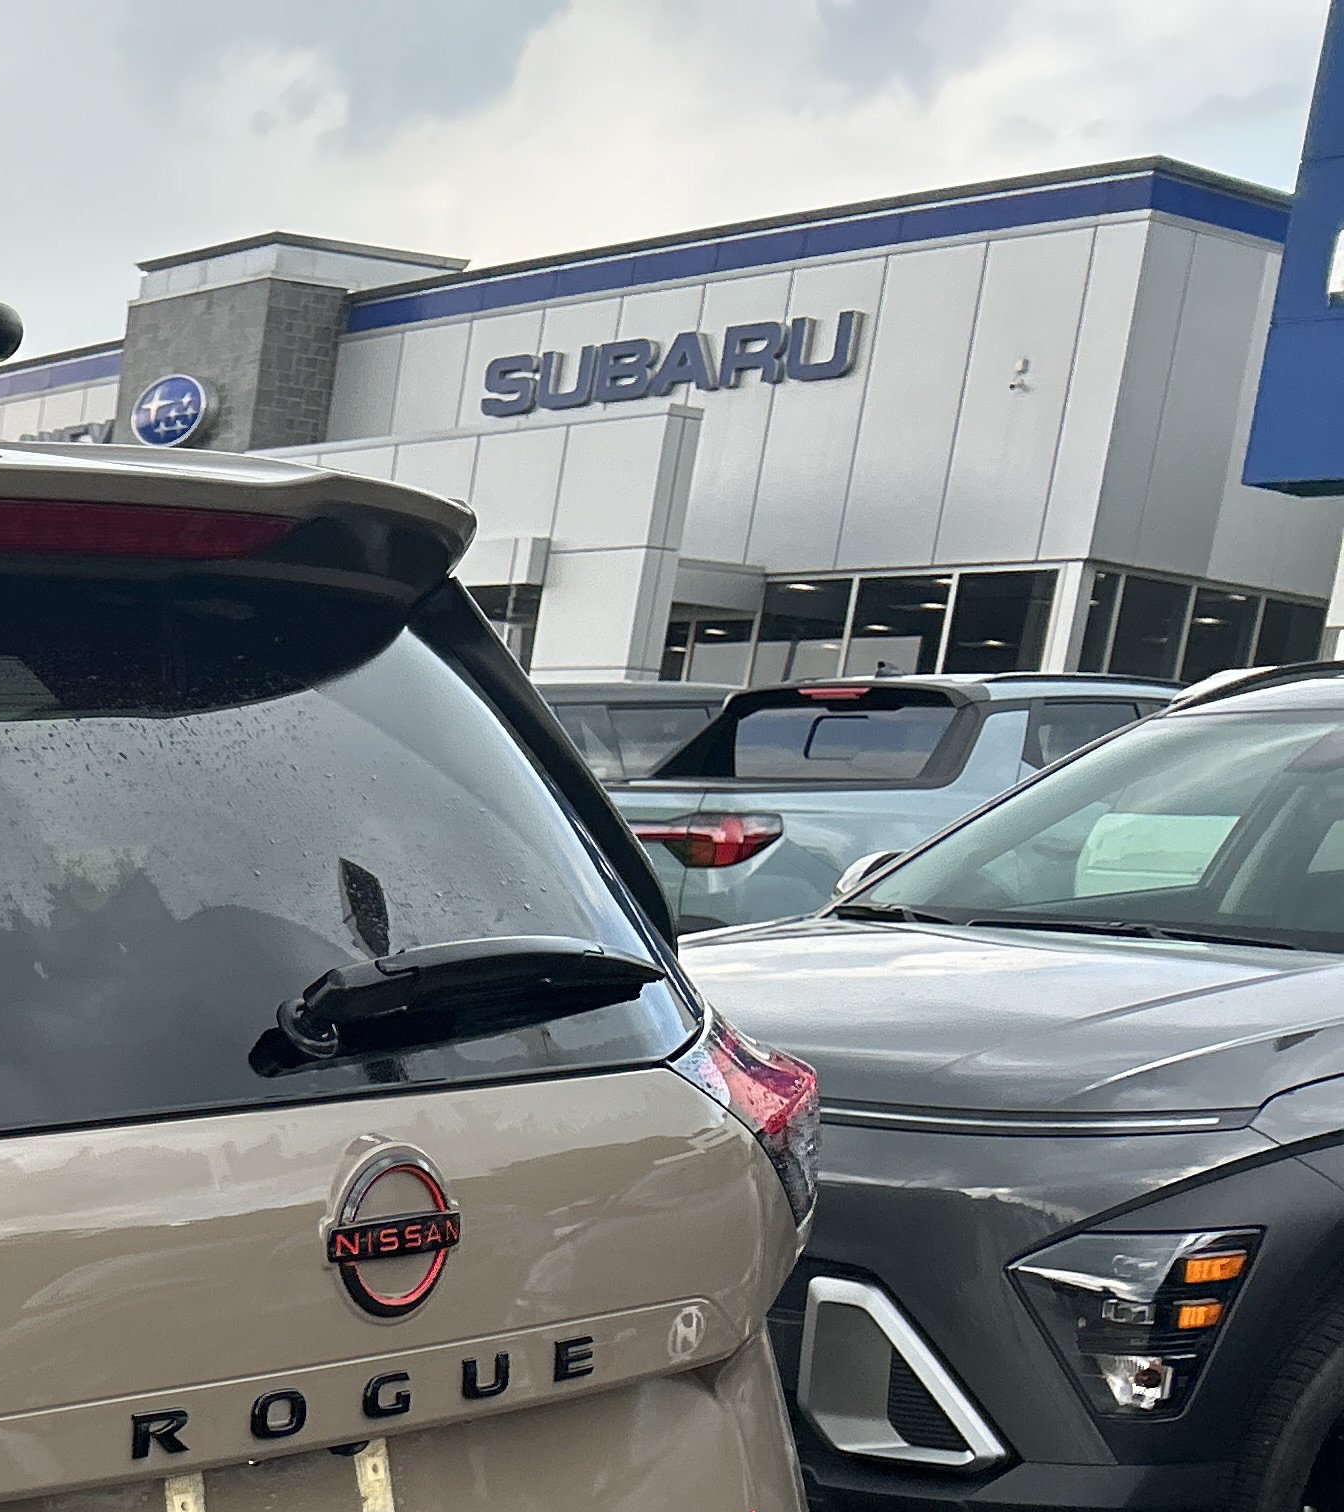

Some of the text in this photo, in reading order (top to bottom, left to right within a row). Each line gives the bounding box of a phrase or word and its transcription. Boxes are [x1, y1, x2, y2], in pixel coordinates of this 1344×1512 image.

[481, 310, 867, 417] SUBARU
[335, 1220, 459, 1256] NISSAN
[131, 1335, 595, 1460] ROGUE
